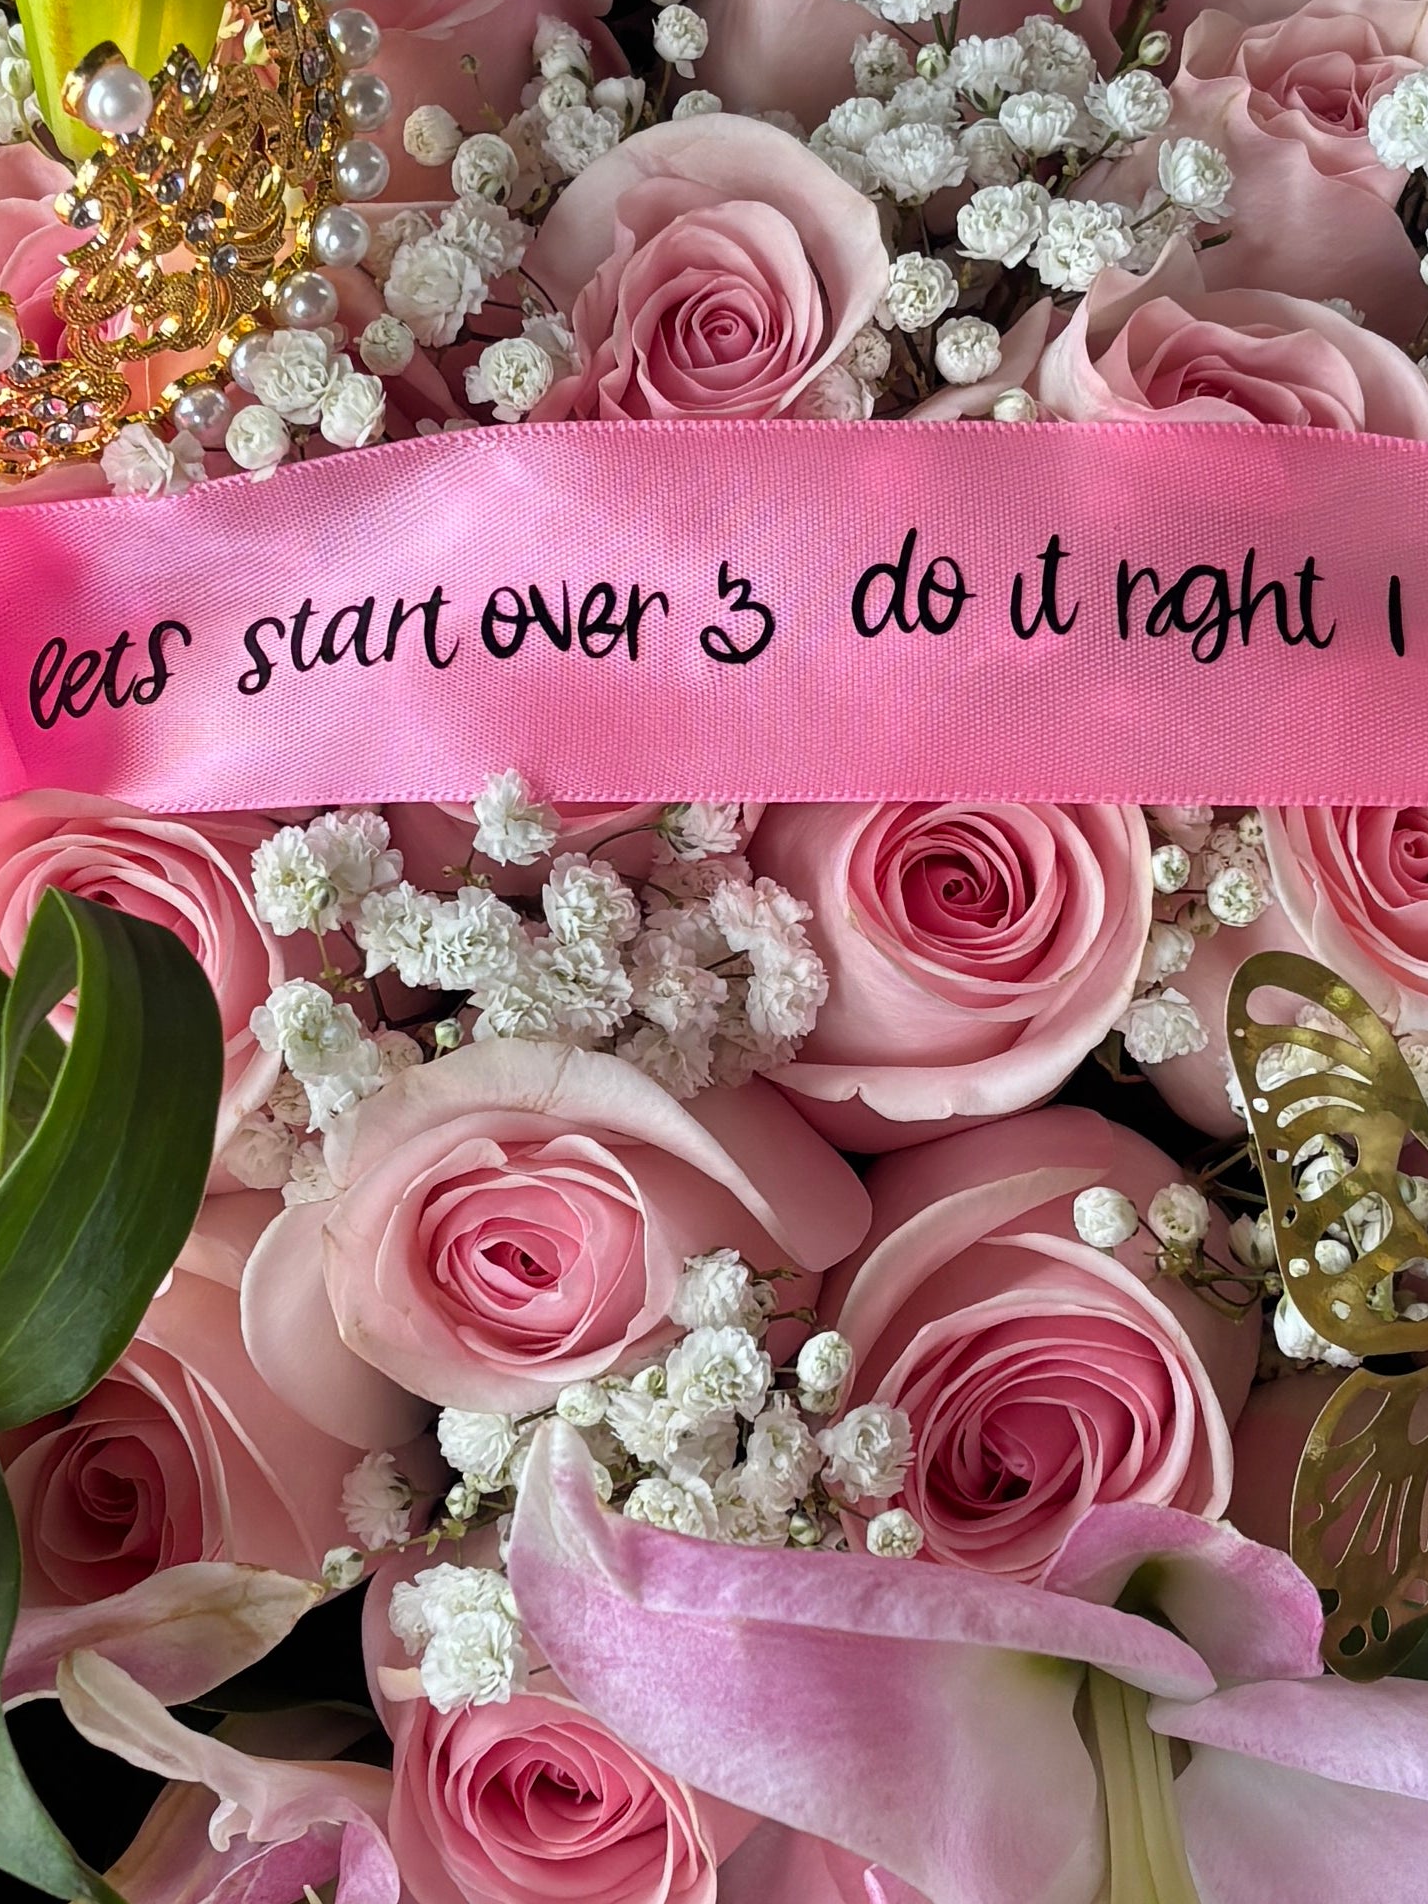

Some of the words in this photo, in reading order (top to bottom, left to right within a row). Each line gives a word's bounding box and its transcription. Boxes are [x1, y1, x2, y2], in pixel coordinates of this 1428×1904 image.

[30, 619, 192, 730] lets
[237, 585, 458, 696] start
[480, 582, 669, 662] over
[851, 527, 976, 638] do
[1010, 534, 1079, 640] it
[1387, 575, 1406, 657] I
